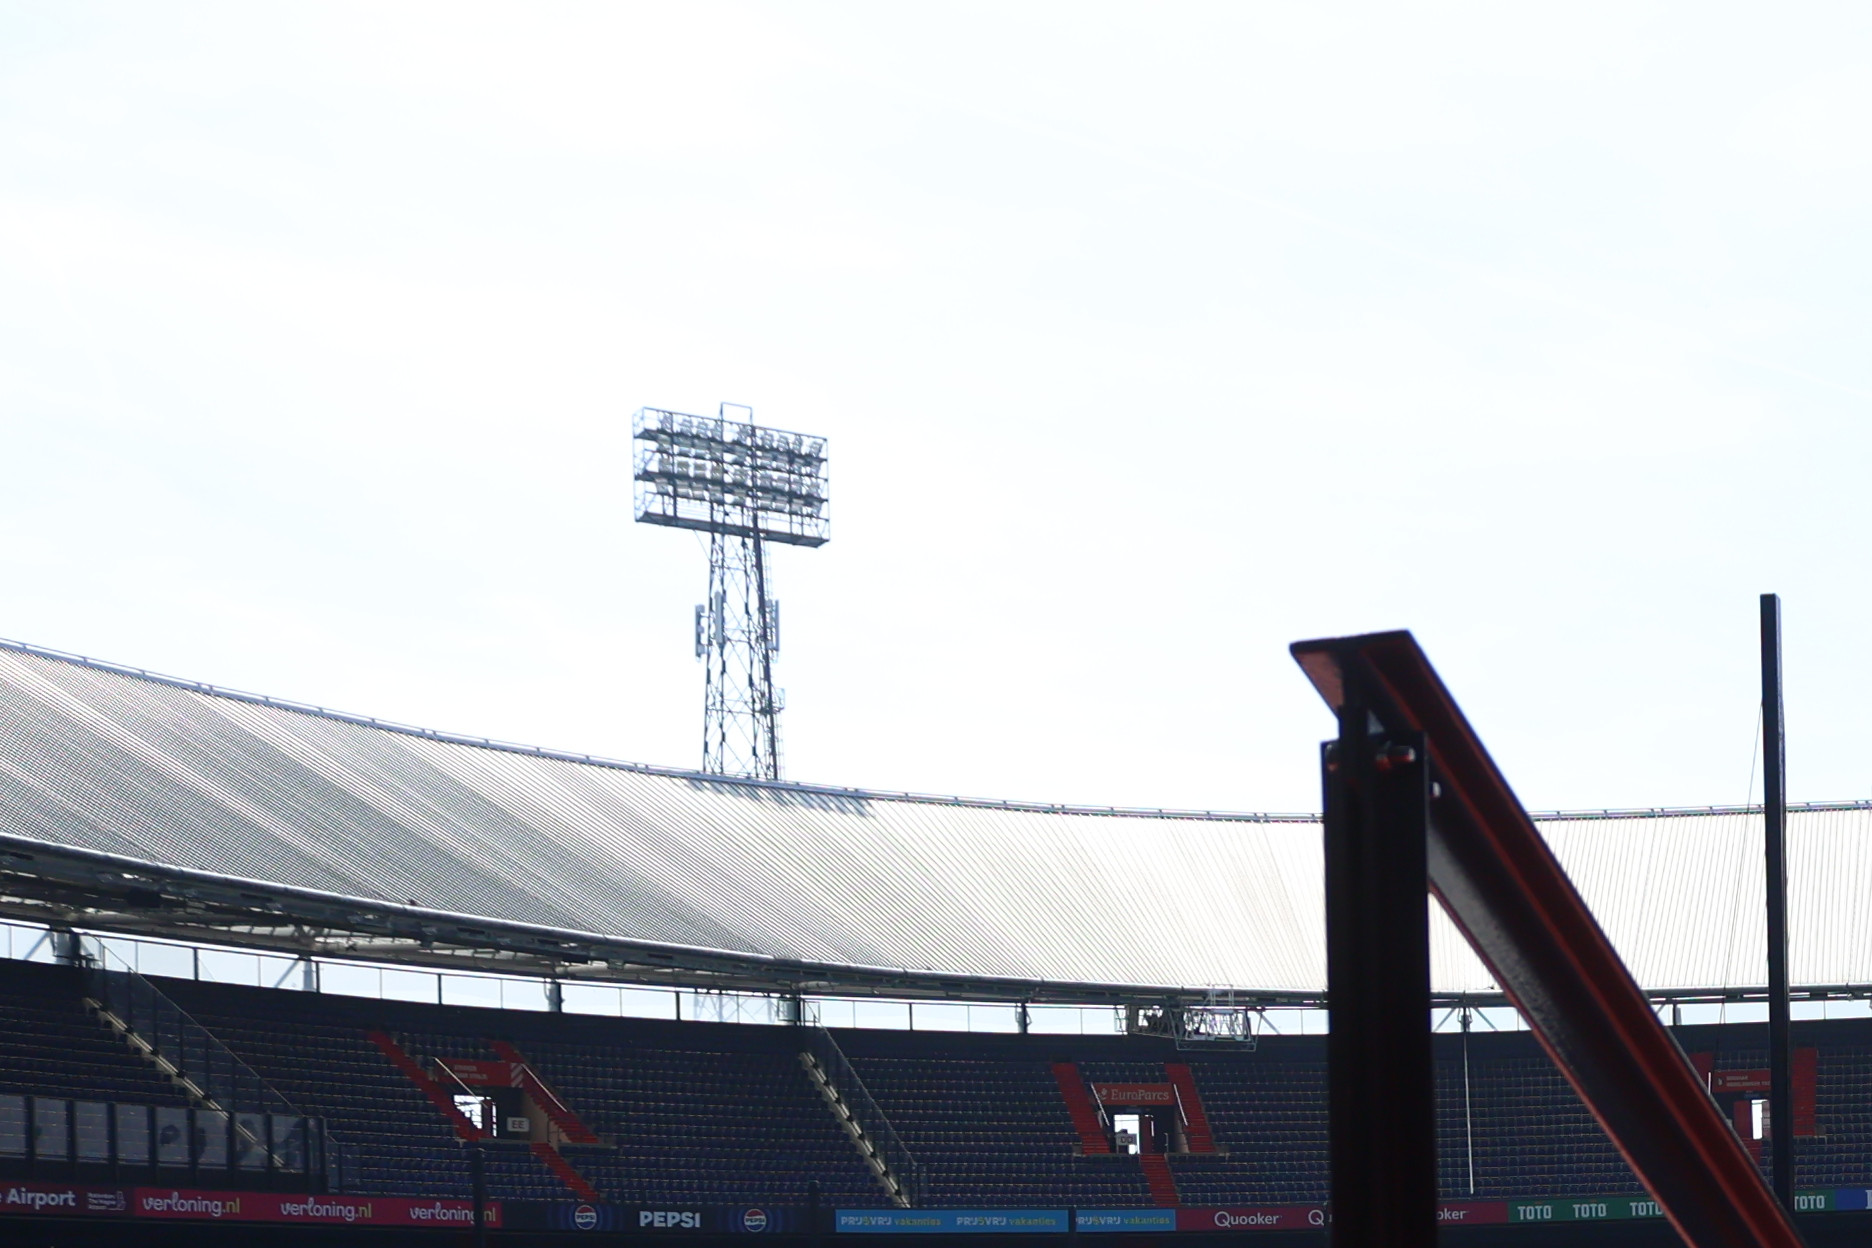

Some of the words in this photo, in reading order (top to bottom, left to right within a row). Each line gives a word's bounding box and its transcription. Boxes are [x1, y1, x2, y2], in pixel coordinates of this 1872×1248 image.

[1111, 1089, 1170, 1101] EuroParcs
[511, 1120, 525, 1129] EE
[7, 1186, 76, 1210] Airport
[142, 1191, 241, 1217] verloning.nl
[280, 1197, 373, 1222] verloning.nl
[1517, 1205, 1553, 1220] TOTO
[1572, 1203, 1607, 1218] TOTO
[639, 1210, 701, 1228] PEPSI
[1213, 1210, 1279, 1229] Quooker
